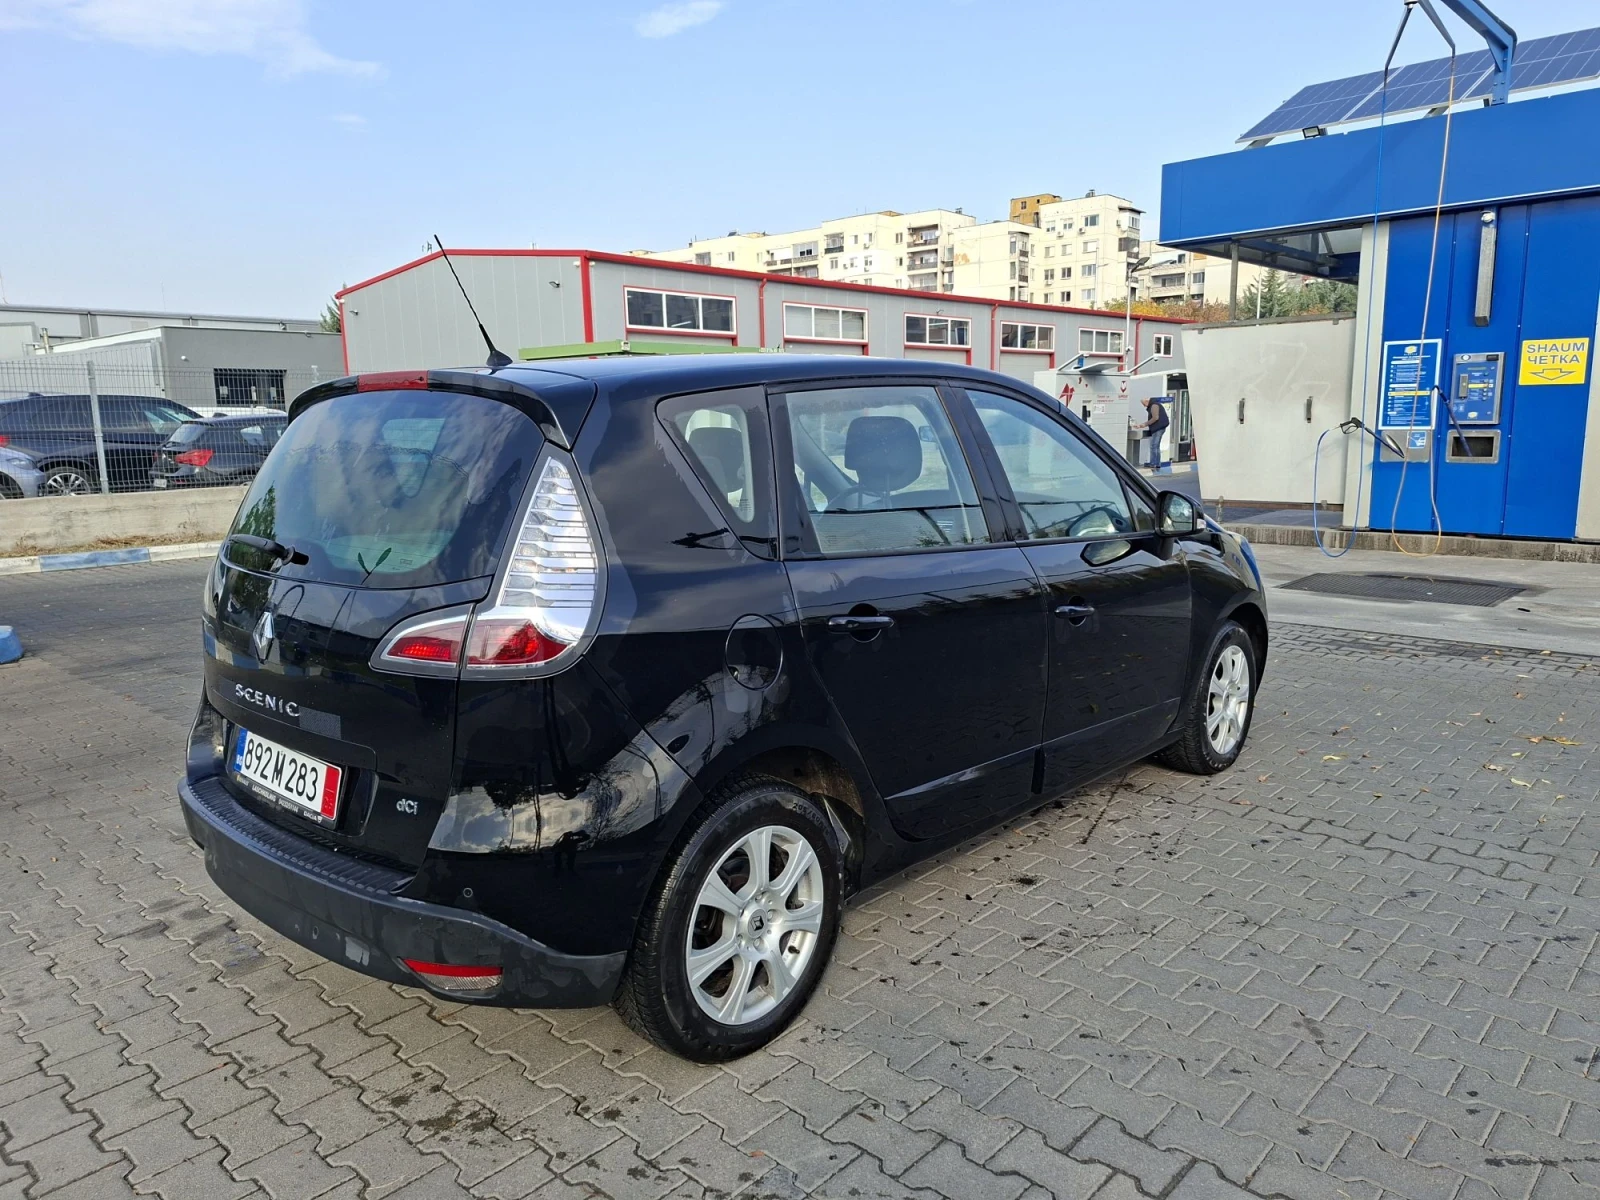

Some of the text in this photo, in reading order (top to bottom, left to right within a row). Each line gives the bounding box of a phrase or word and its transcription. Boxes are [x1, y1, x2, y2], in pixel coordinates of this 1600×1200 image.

[1527, 342, 1585, 353] SHAUM
[1528, 354, 1580, 365] ЧЕТКА
[235, 683, 301, 717] SCENIC
[244, 738, 318, 802] 892M283
[396, 798, 418, 815] dCi
